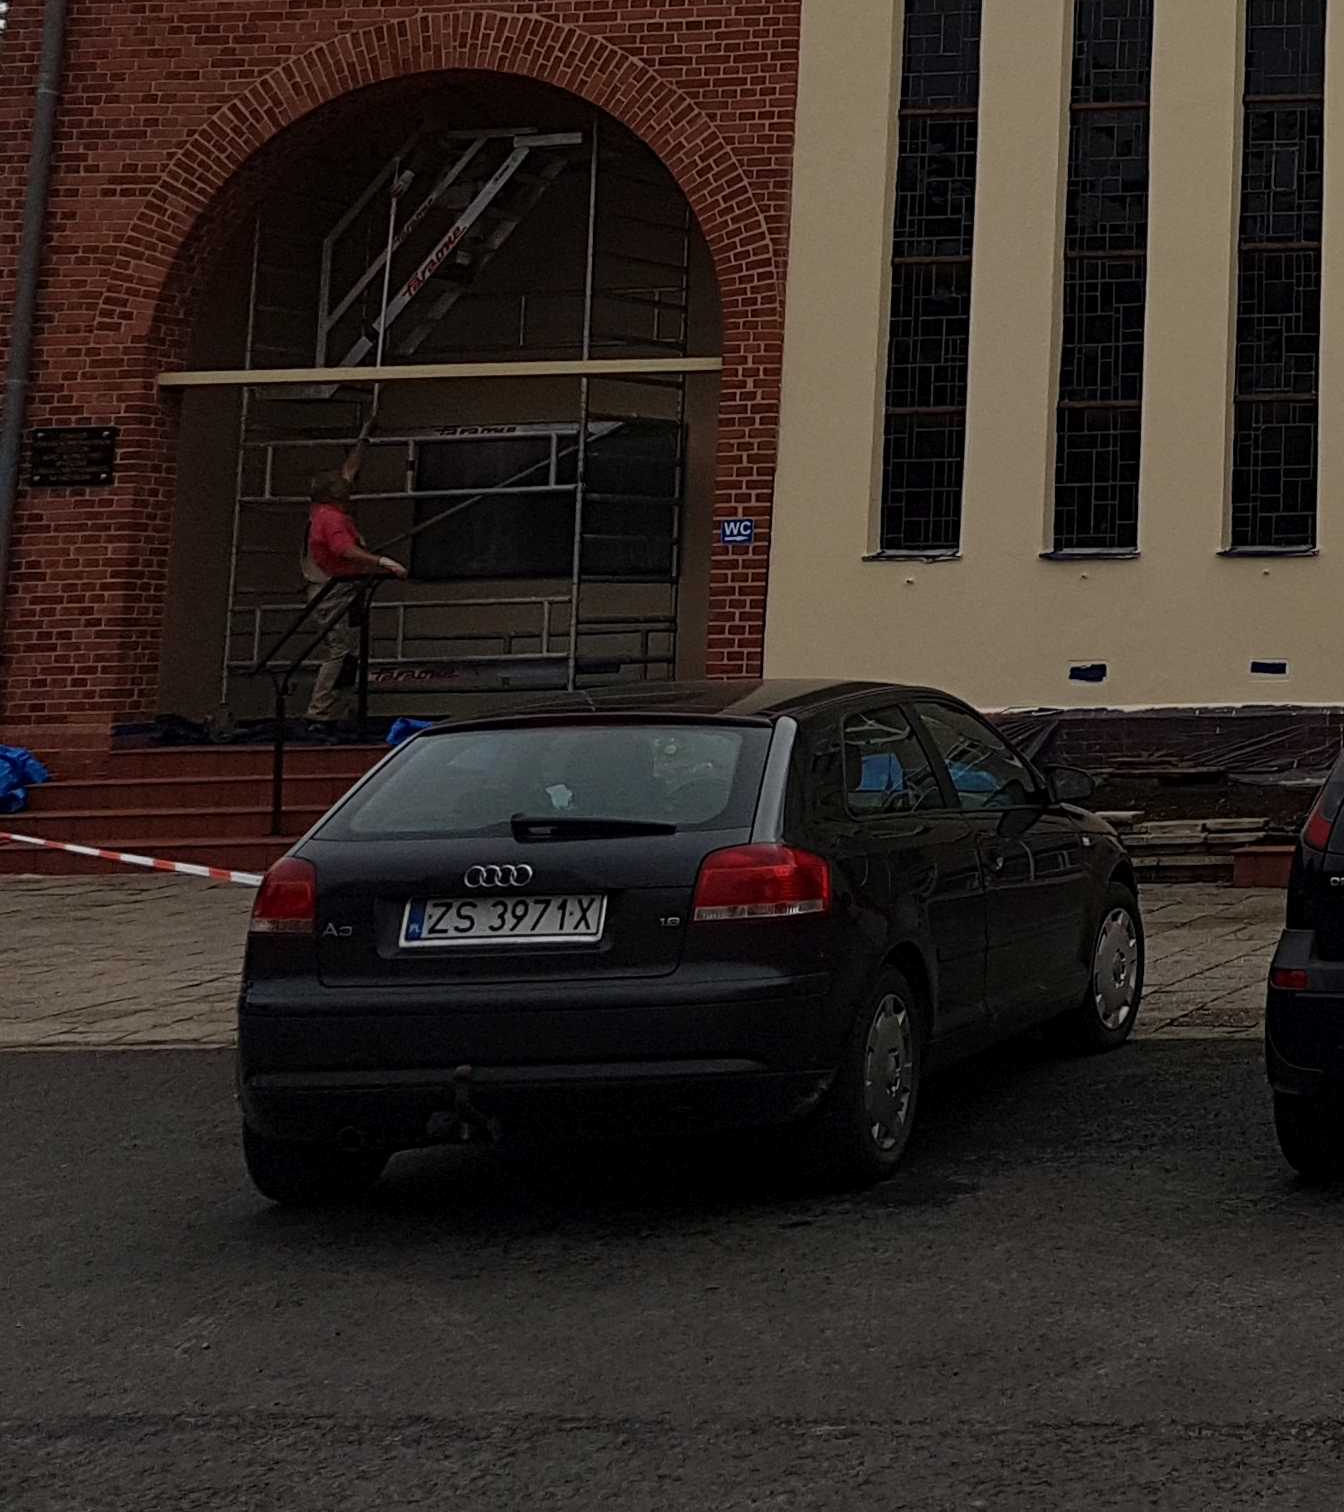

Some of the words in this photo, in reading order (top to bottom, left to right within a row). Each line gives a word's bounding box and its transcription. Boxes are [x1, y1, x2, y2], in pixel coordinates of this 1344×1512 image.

[724, 521, 752, 535] WC
[428, 902, 477, 934] ZS
[489, 898, 595, 932] 3971X
[322, 921, 353, 937] A3
